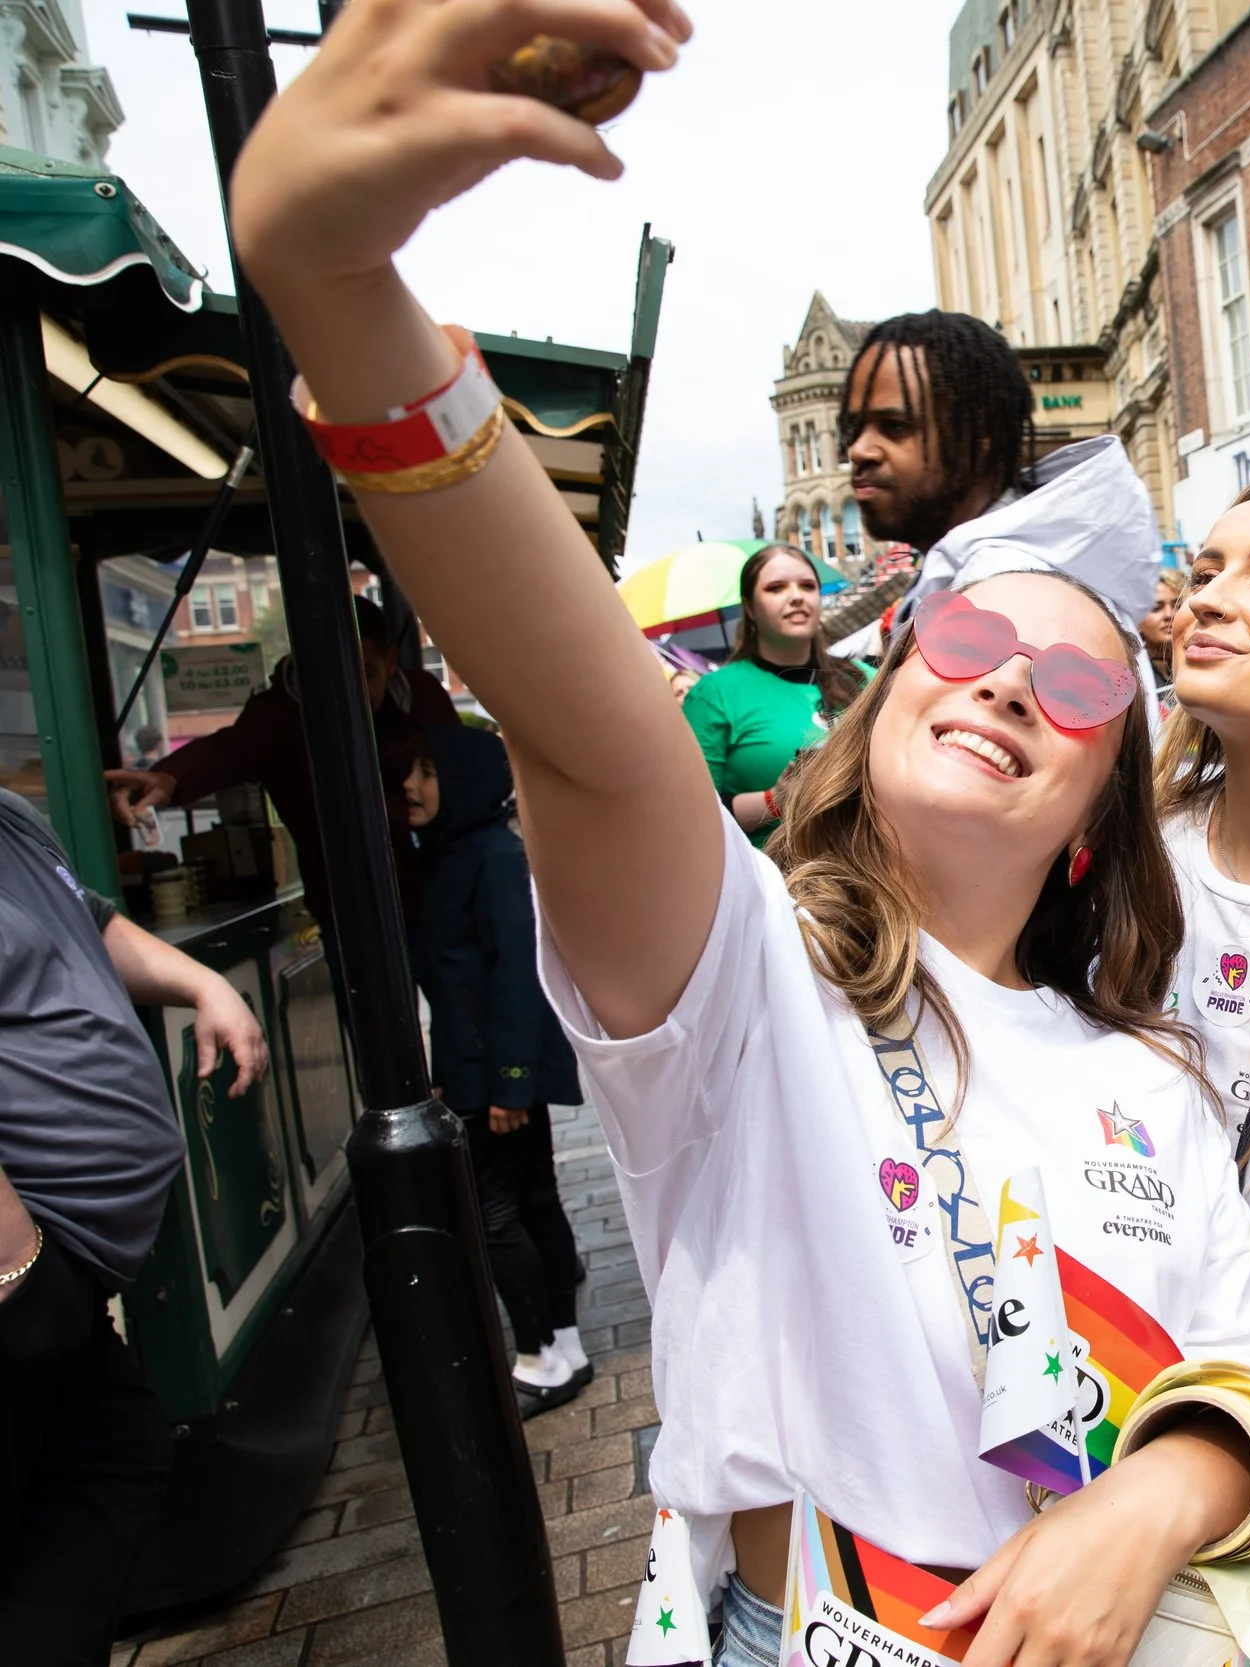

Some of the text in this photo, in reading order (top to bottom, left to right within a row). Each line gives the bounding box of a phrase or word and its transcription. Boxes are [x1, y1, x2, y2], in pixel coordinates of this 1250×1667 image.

[1042, 395, 1083, 410] BANK
[1206, 996, 1245, 1015] PRIDE
[1083, 1159, 1158, 1175] WOLVERHAMPTON
[1084, 1168, 1175, 1208] GRAND
[1123, 1215, 1152, 1225] THEATRE
[1151, 1204, 1174, 1220] THEATRE
[1102, 1220, 1172, 1246] everyone
